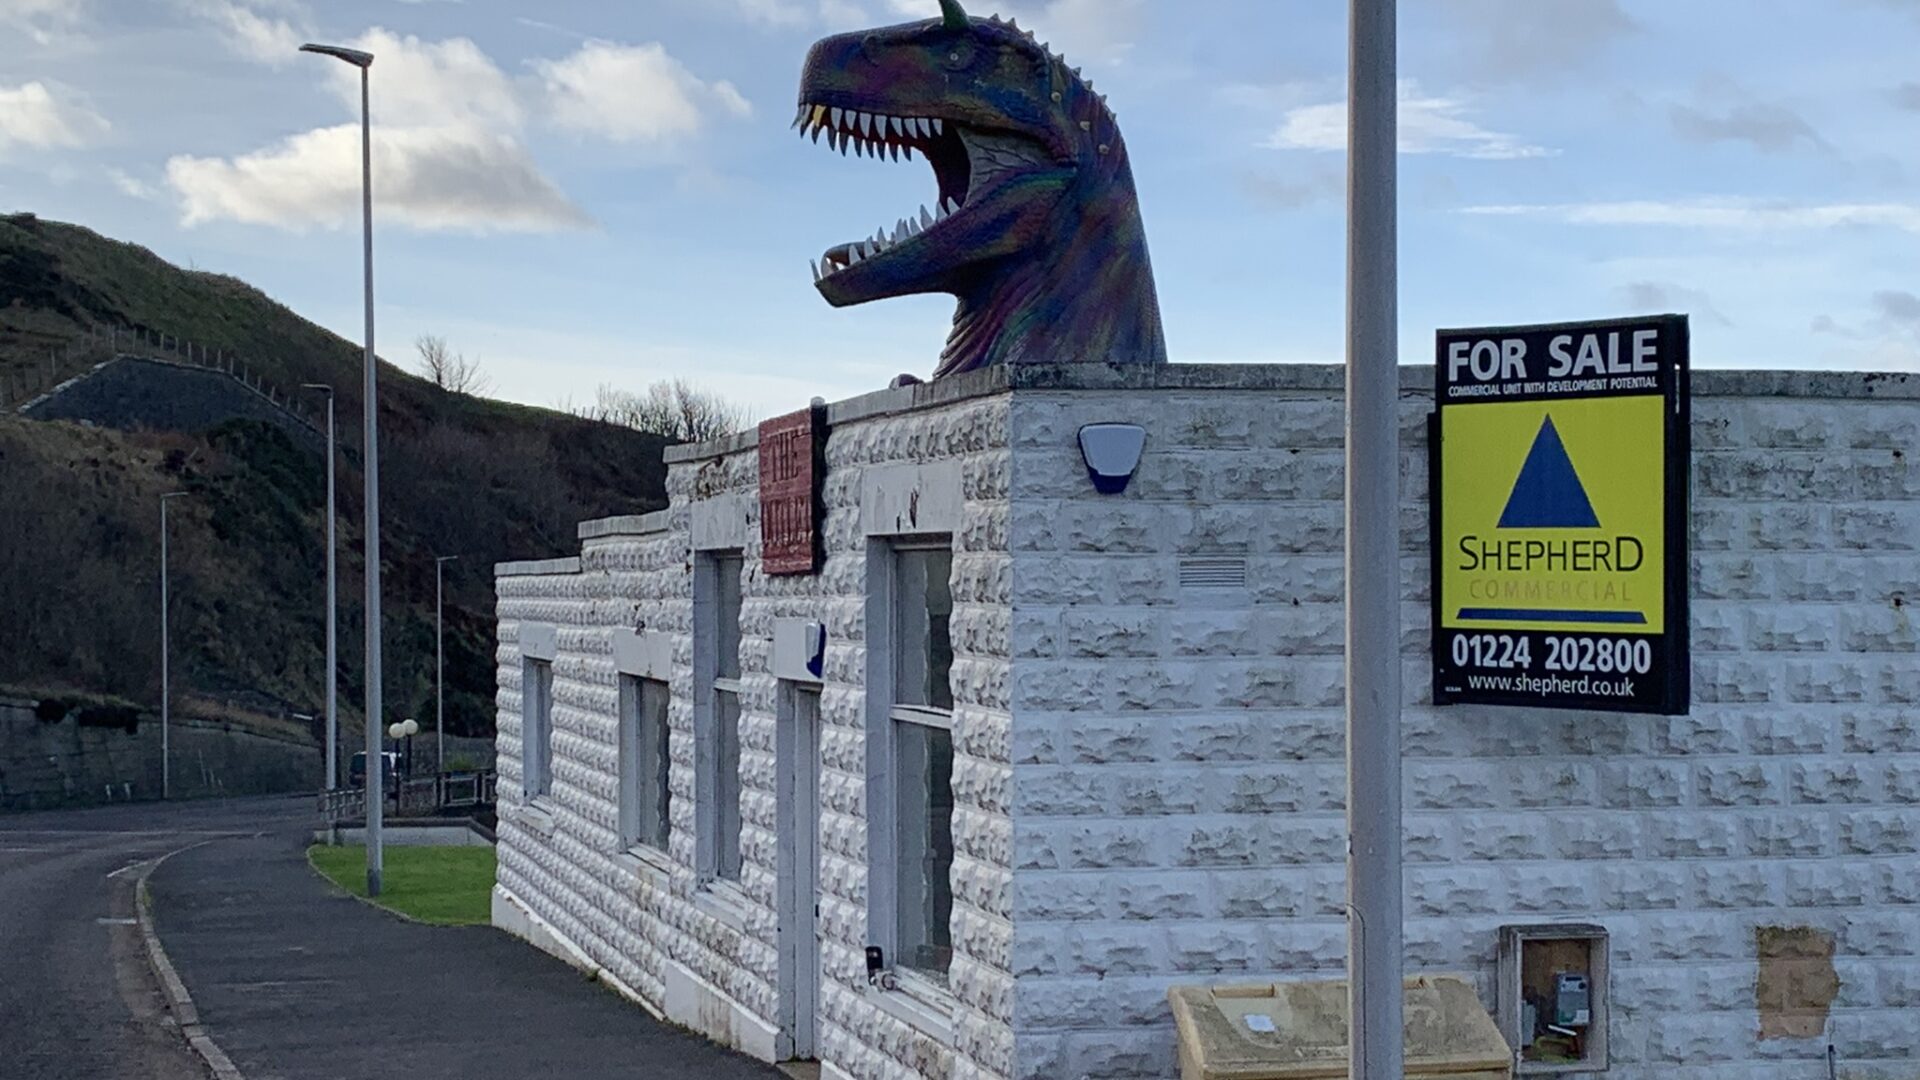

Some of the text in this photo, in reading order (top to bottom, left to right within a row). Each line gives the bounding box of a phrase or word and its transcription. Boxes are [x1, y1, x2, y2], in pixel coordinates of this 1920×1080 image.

[1448, 329, 1659, 382] FOR SALE
[1448, 376, 1658, 397] COMMERCIAL UNIT WITH DEVELOPMENT POTENTIAL
[768, 430, 800, 482] THE
[1459, 535, 1644, 572] SHEPHERD
[1469, 578, 1633, 601] COMMERCIAL
[1452, 633, 1651, 674] 01224 202800
[1468, 672, 1635, 697] www.shepherd.co.uk
